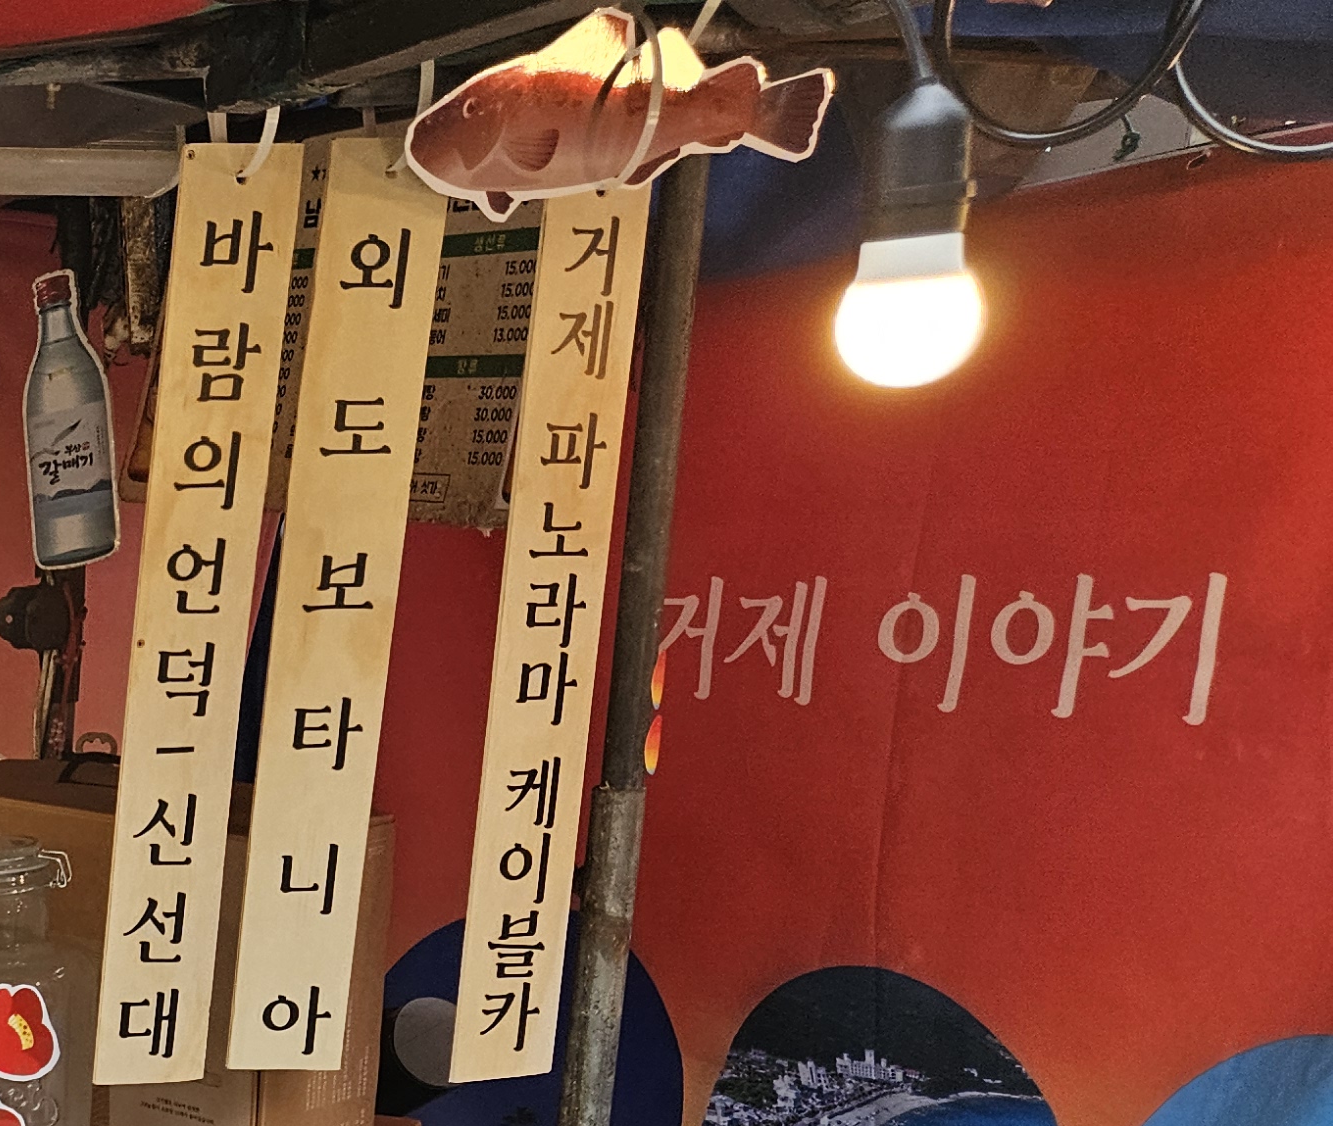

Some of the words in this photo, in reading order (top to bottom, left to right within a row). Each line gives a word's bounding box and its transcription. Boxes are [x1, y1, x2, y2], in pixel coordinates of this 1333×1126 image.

[550, 216, 622, 380] 거제
[38, 451, 94, 486] 갈매기
[515, 411, 608, 727] 파노라마
[261, 227, 413, 1056] 외도보타니아
[659, 574, 827, 706] 거제
[877, 571, 1228, 726] 이야기
[480, 756, 562, 1053] 케이블카
